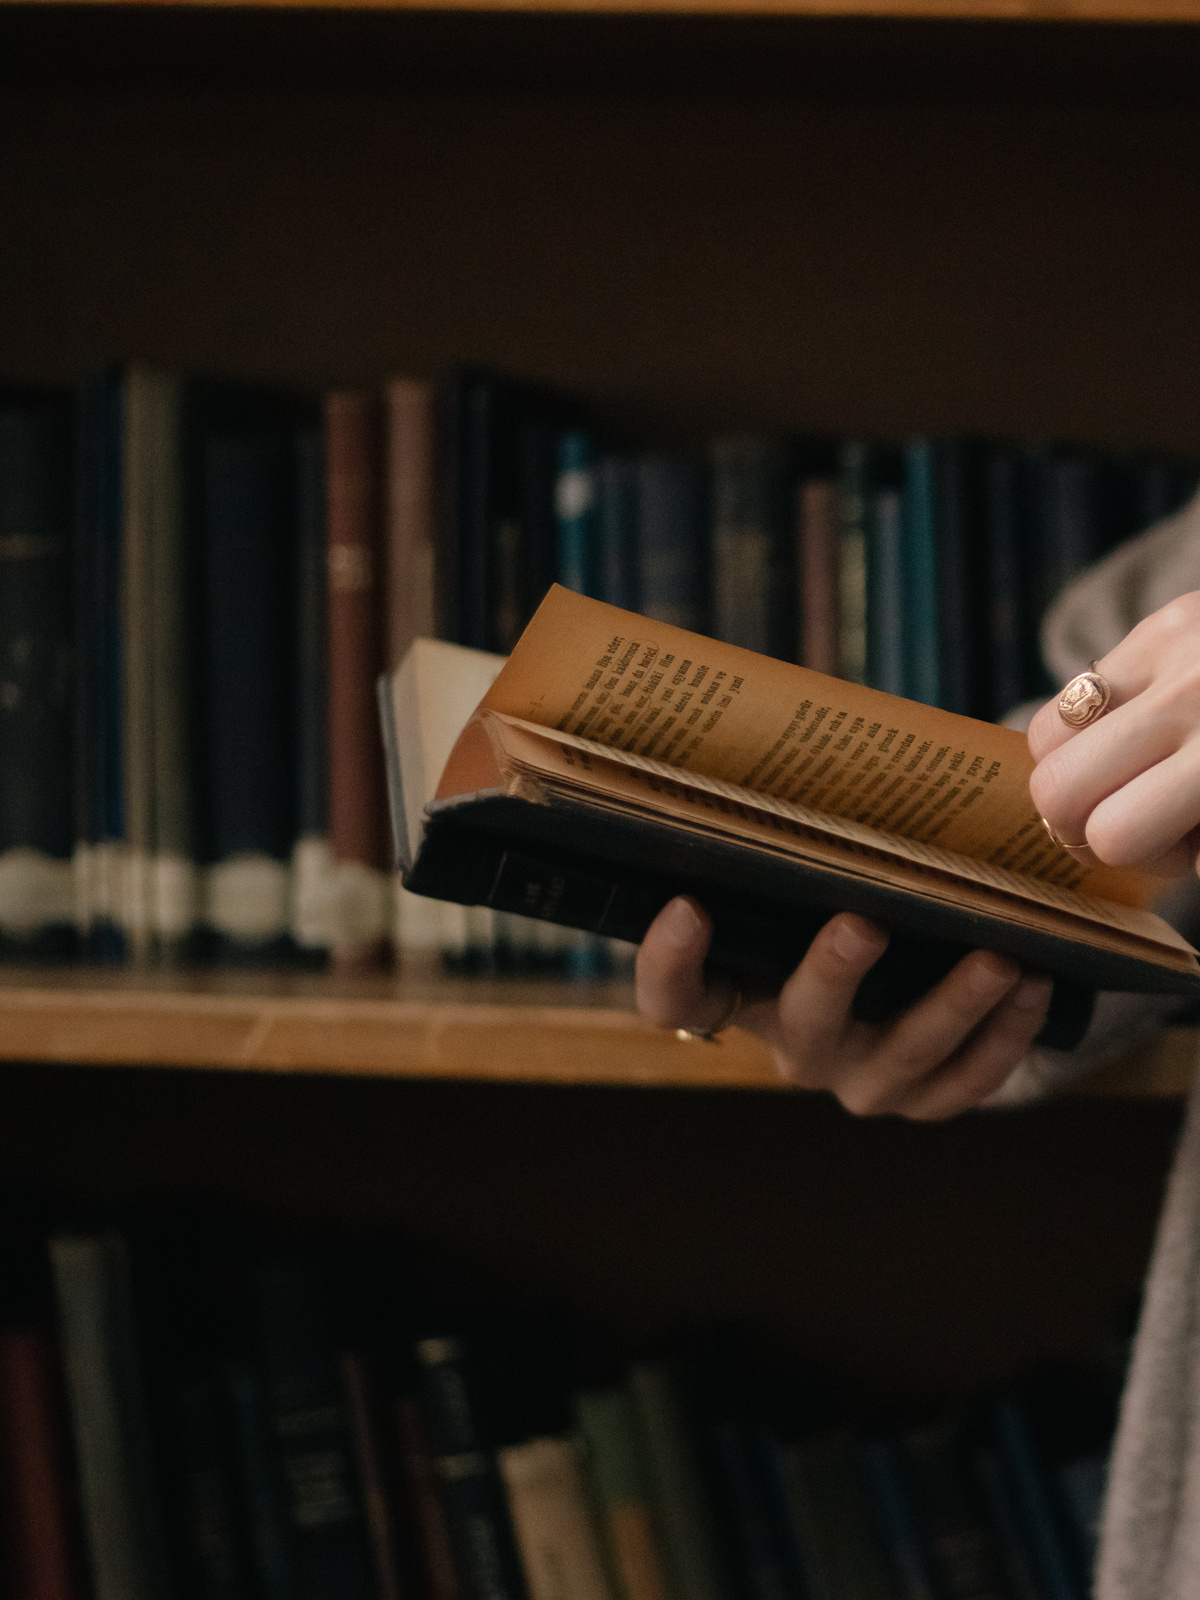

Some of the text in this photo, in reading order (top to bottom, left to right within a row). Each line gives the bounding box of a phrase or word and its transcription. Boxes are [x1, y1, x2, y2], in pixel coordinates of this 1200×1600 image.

[606, 635, 625, 655] eder;
[700, 680, 721, 706] noksan
[728, 675, 745, 695] yani
[794, 699, 814, 721] görür
[848, 716, 866, 734] eşya
[866, 722, 883, 739] asla
[877, 728, 900, 754] gitmek
[981, 760, 1002, 784] doğru
